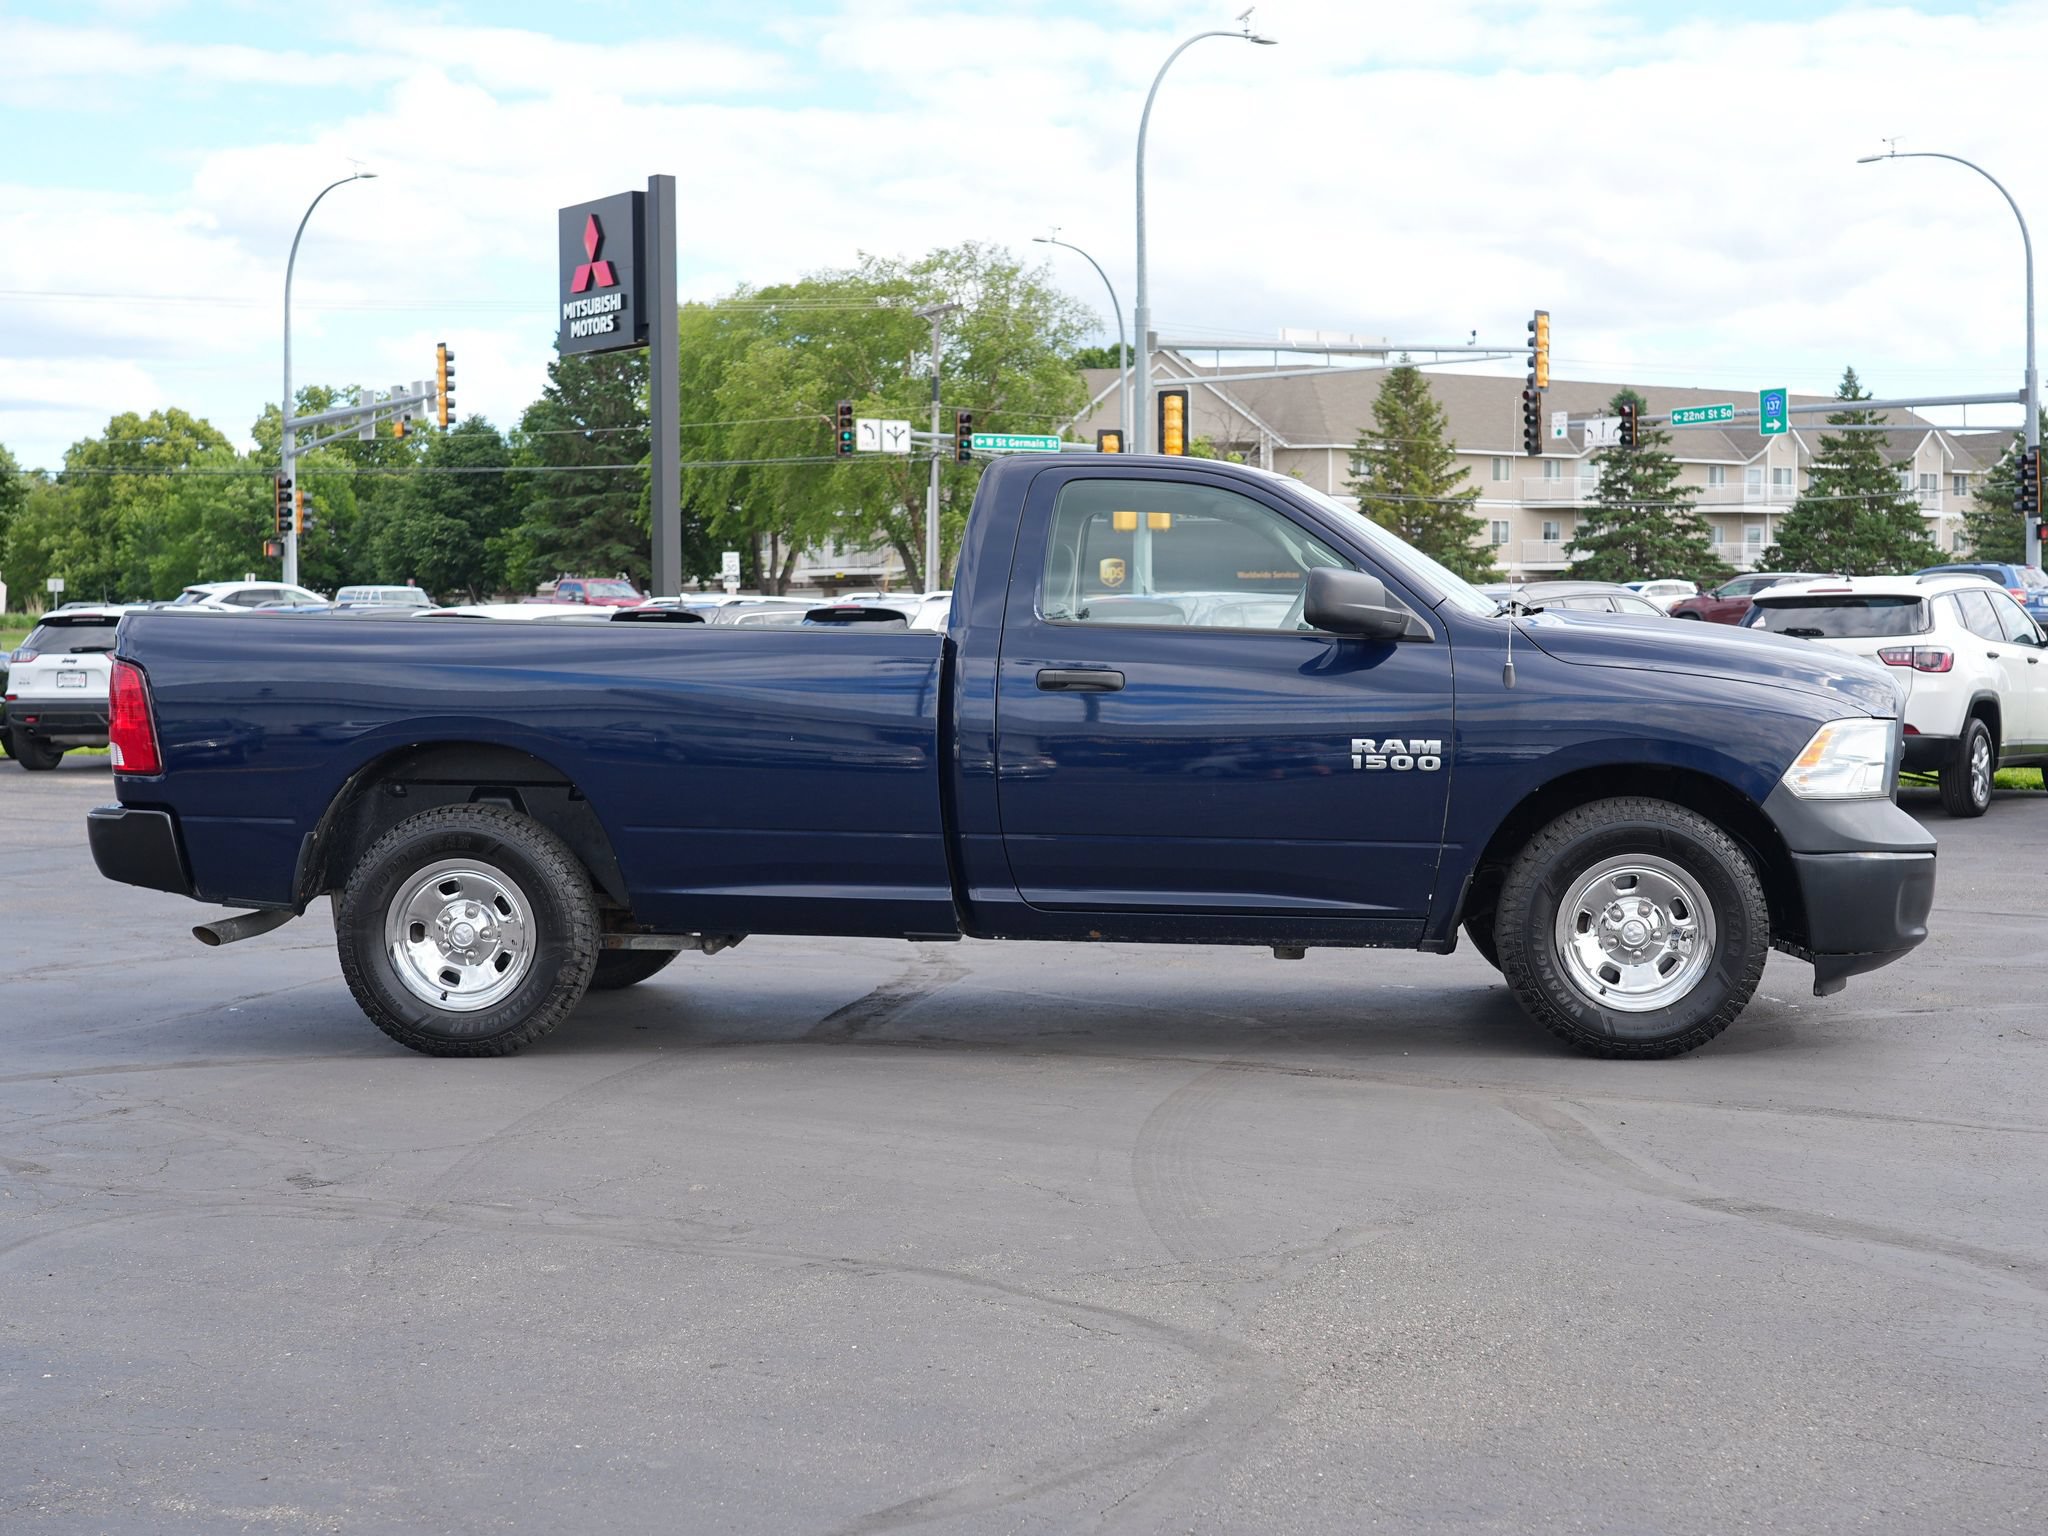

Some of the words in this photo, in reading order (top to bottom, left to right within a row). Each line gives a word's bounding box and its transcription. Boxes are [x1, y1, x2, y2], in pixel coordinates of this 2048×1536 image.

[563, 293, 621, 320] MITSUBISHI
[571, 314, 614, 338] MOTORS
[1766, 401, 1780, 411] 137
[1683, 411, 1705, 421] 22nd
[1708, 409, 1718, 419] St
[1720, 408, 1732, 418] So
[985, 438, 994, 446] W
[995, 438, 1006, 447] St
[1008, 438, 1045, 448] Germain
[1046, 439, 1057, 448] St
[1352, 739, 1442, 754] RAM
[1351, 755, 1441, 771] 1500
[1531, 915, 1583, 1018] WRANGLER
